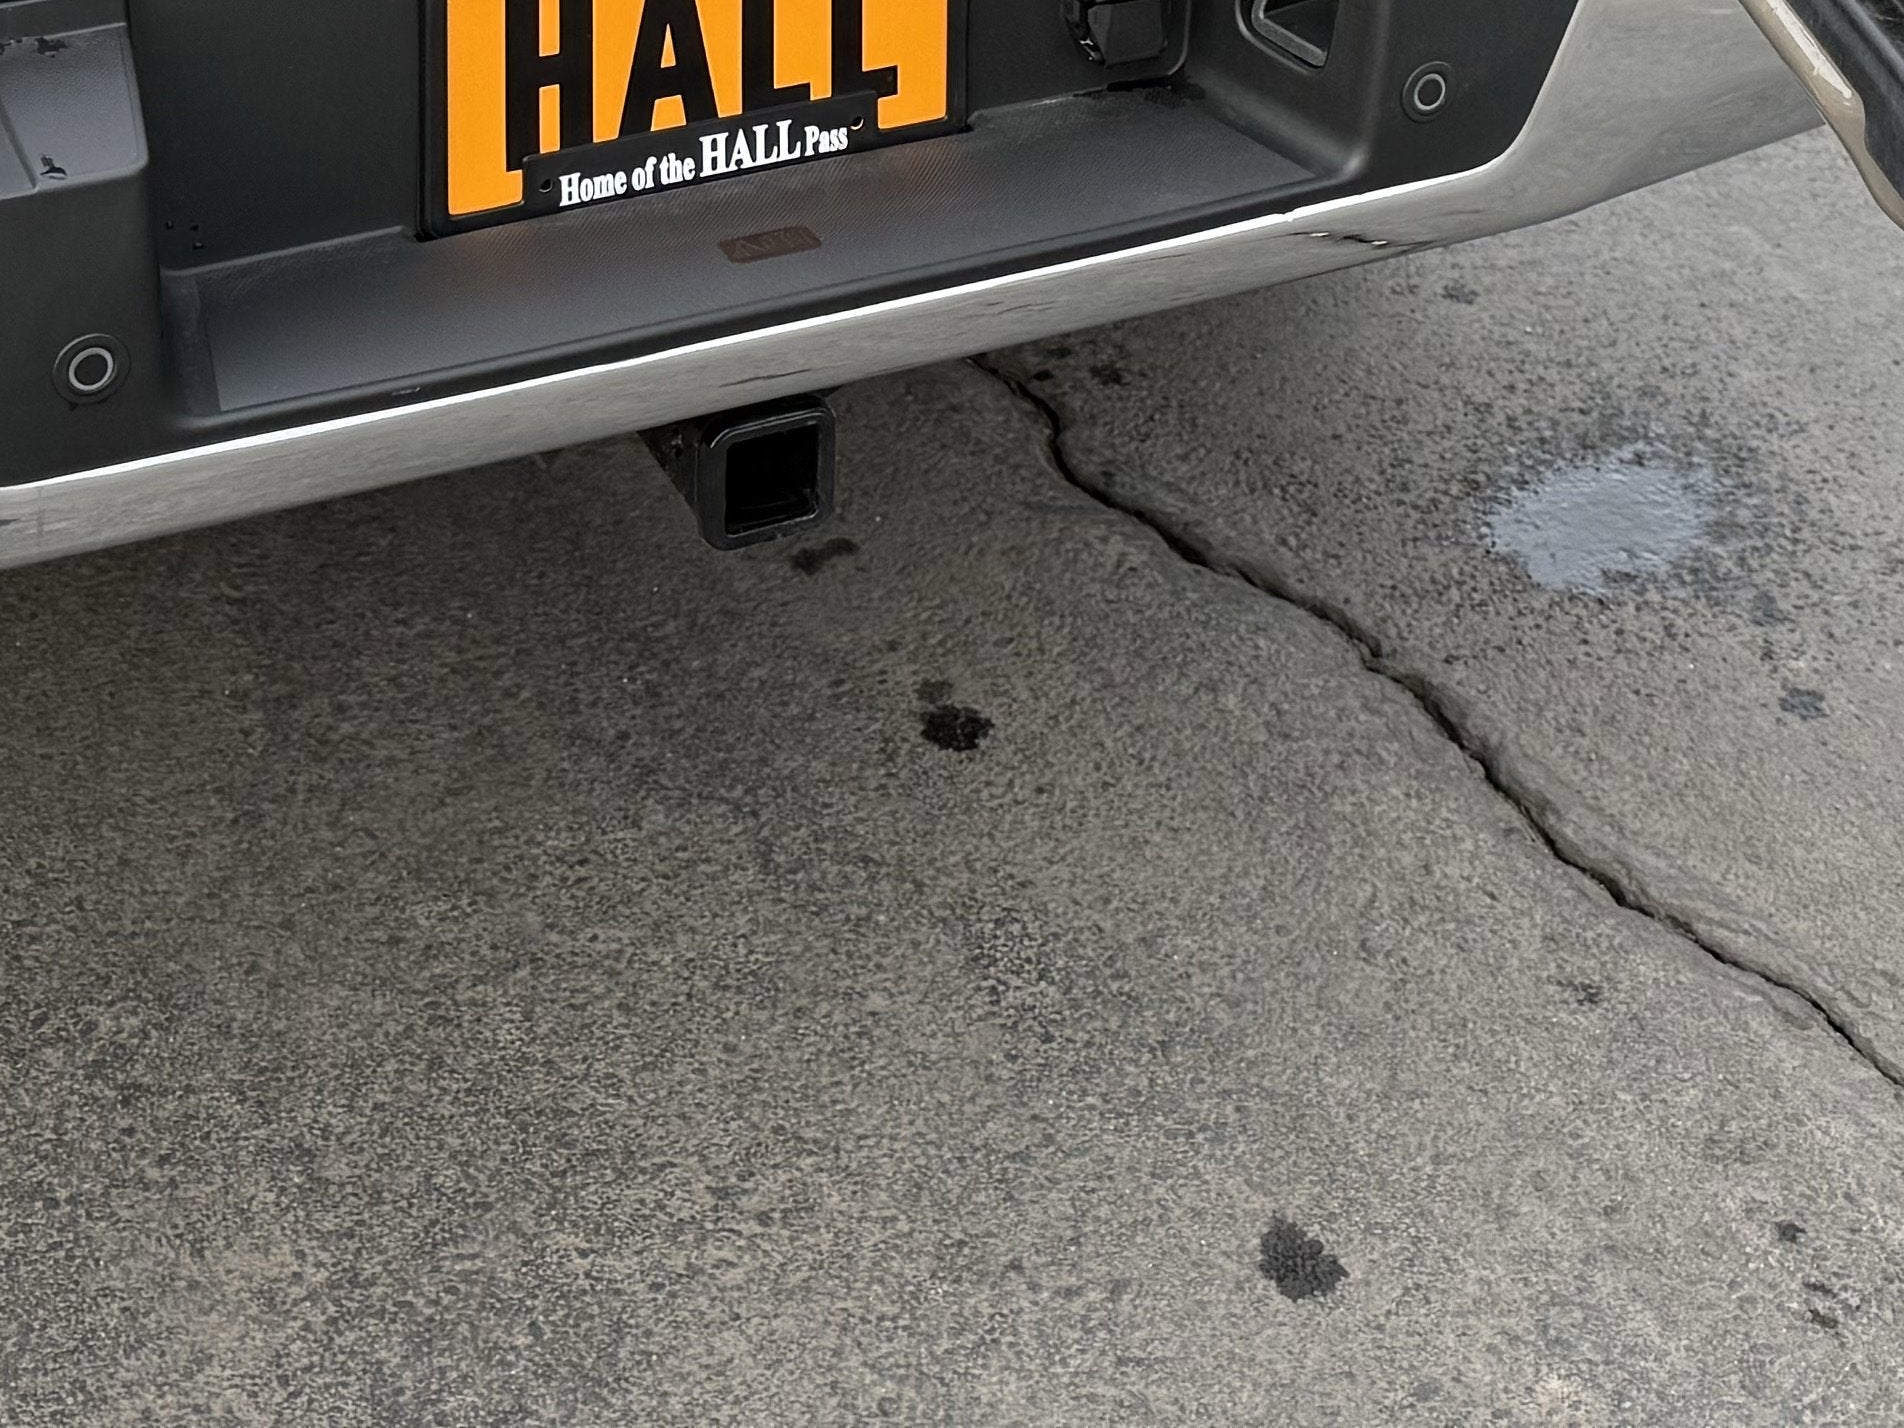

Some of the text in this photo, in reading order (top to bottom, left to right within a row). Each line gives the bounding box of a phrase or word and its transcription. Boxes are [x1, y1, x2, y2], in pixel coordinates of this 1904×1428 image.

[559, 119, 849, 207] Home of the HALL Pass
